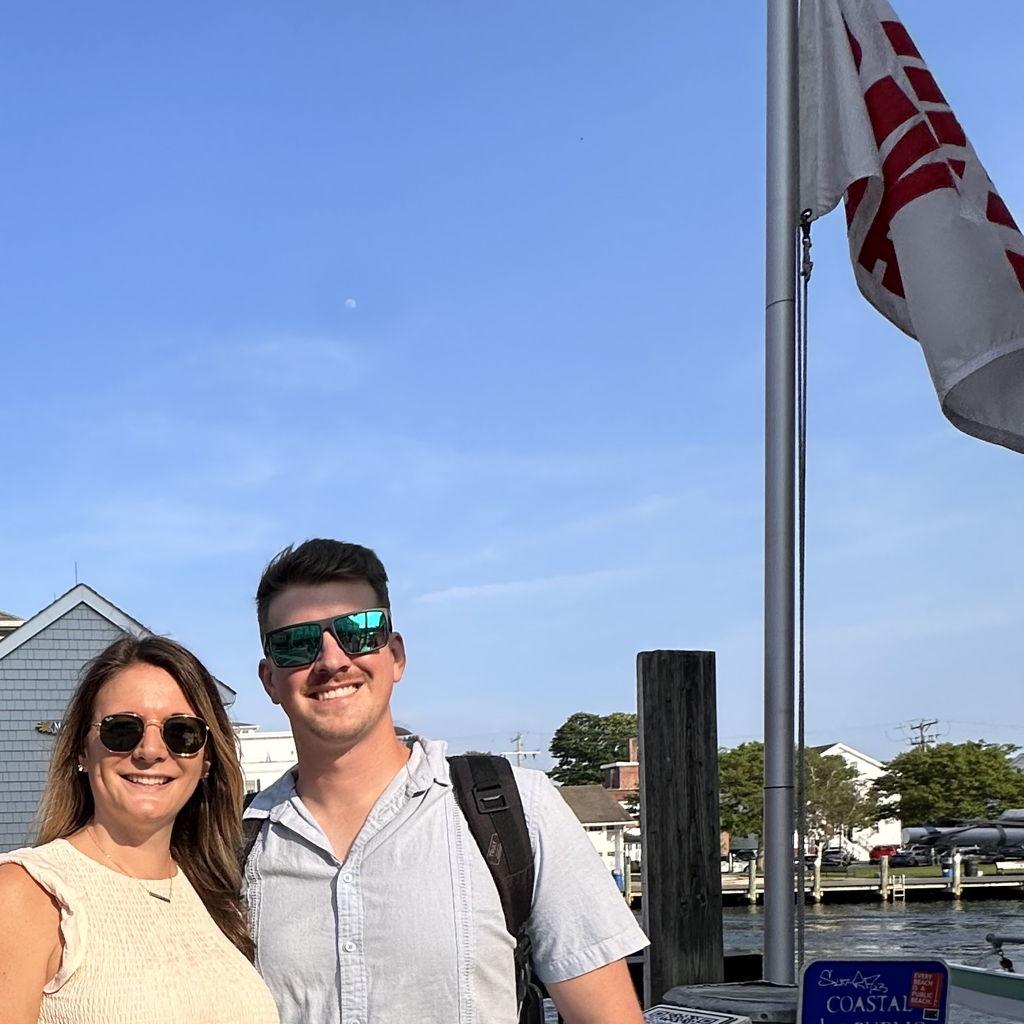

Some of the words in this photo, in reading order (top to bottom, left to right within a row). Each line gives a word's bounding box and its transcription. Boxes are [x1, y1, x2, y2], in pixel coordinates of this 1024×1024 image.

[913, 972, 933, 980] EVERY
[913, 979, 933, 987] BEACH
[826, 995, 913, 1013] COASTAL
